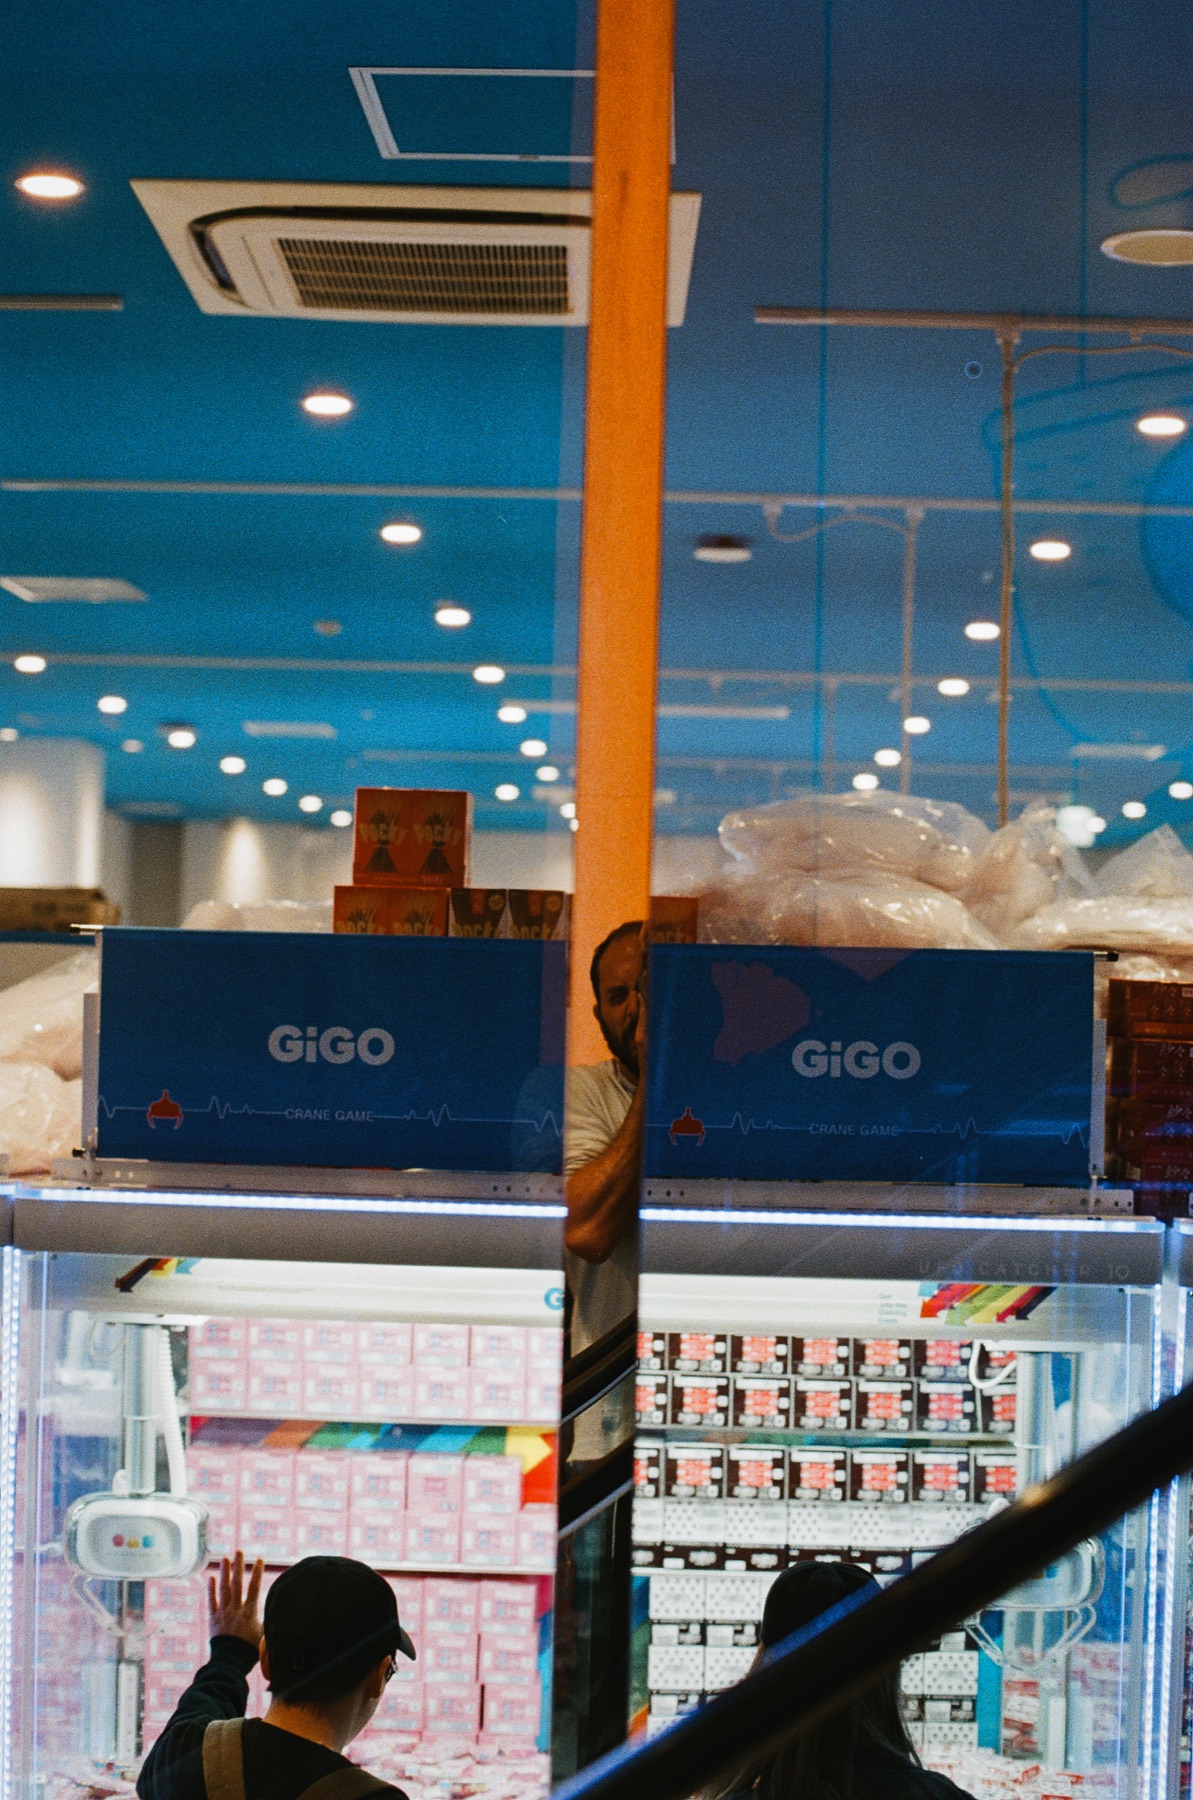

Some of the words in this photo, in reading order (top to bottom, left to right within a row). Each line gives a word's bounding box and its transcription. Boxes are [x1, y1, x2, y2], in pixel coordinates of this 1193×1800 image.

[268, 1024, 396, 1066] GiGO
[791, 1039, 921, 1080] GiGO
[285, 1107, 331, 1120] CRANE
[334, 1109, 374, 1122] GAME
[809, 1122, 856, 1135] CRANE
[860, 1124, 899, 1137] GAME
